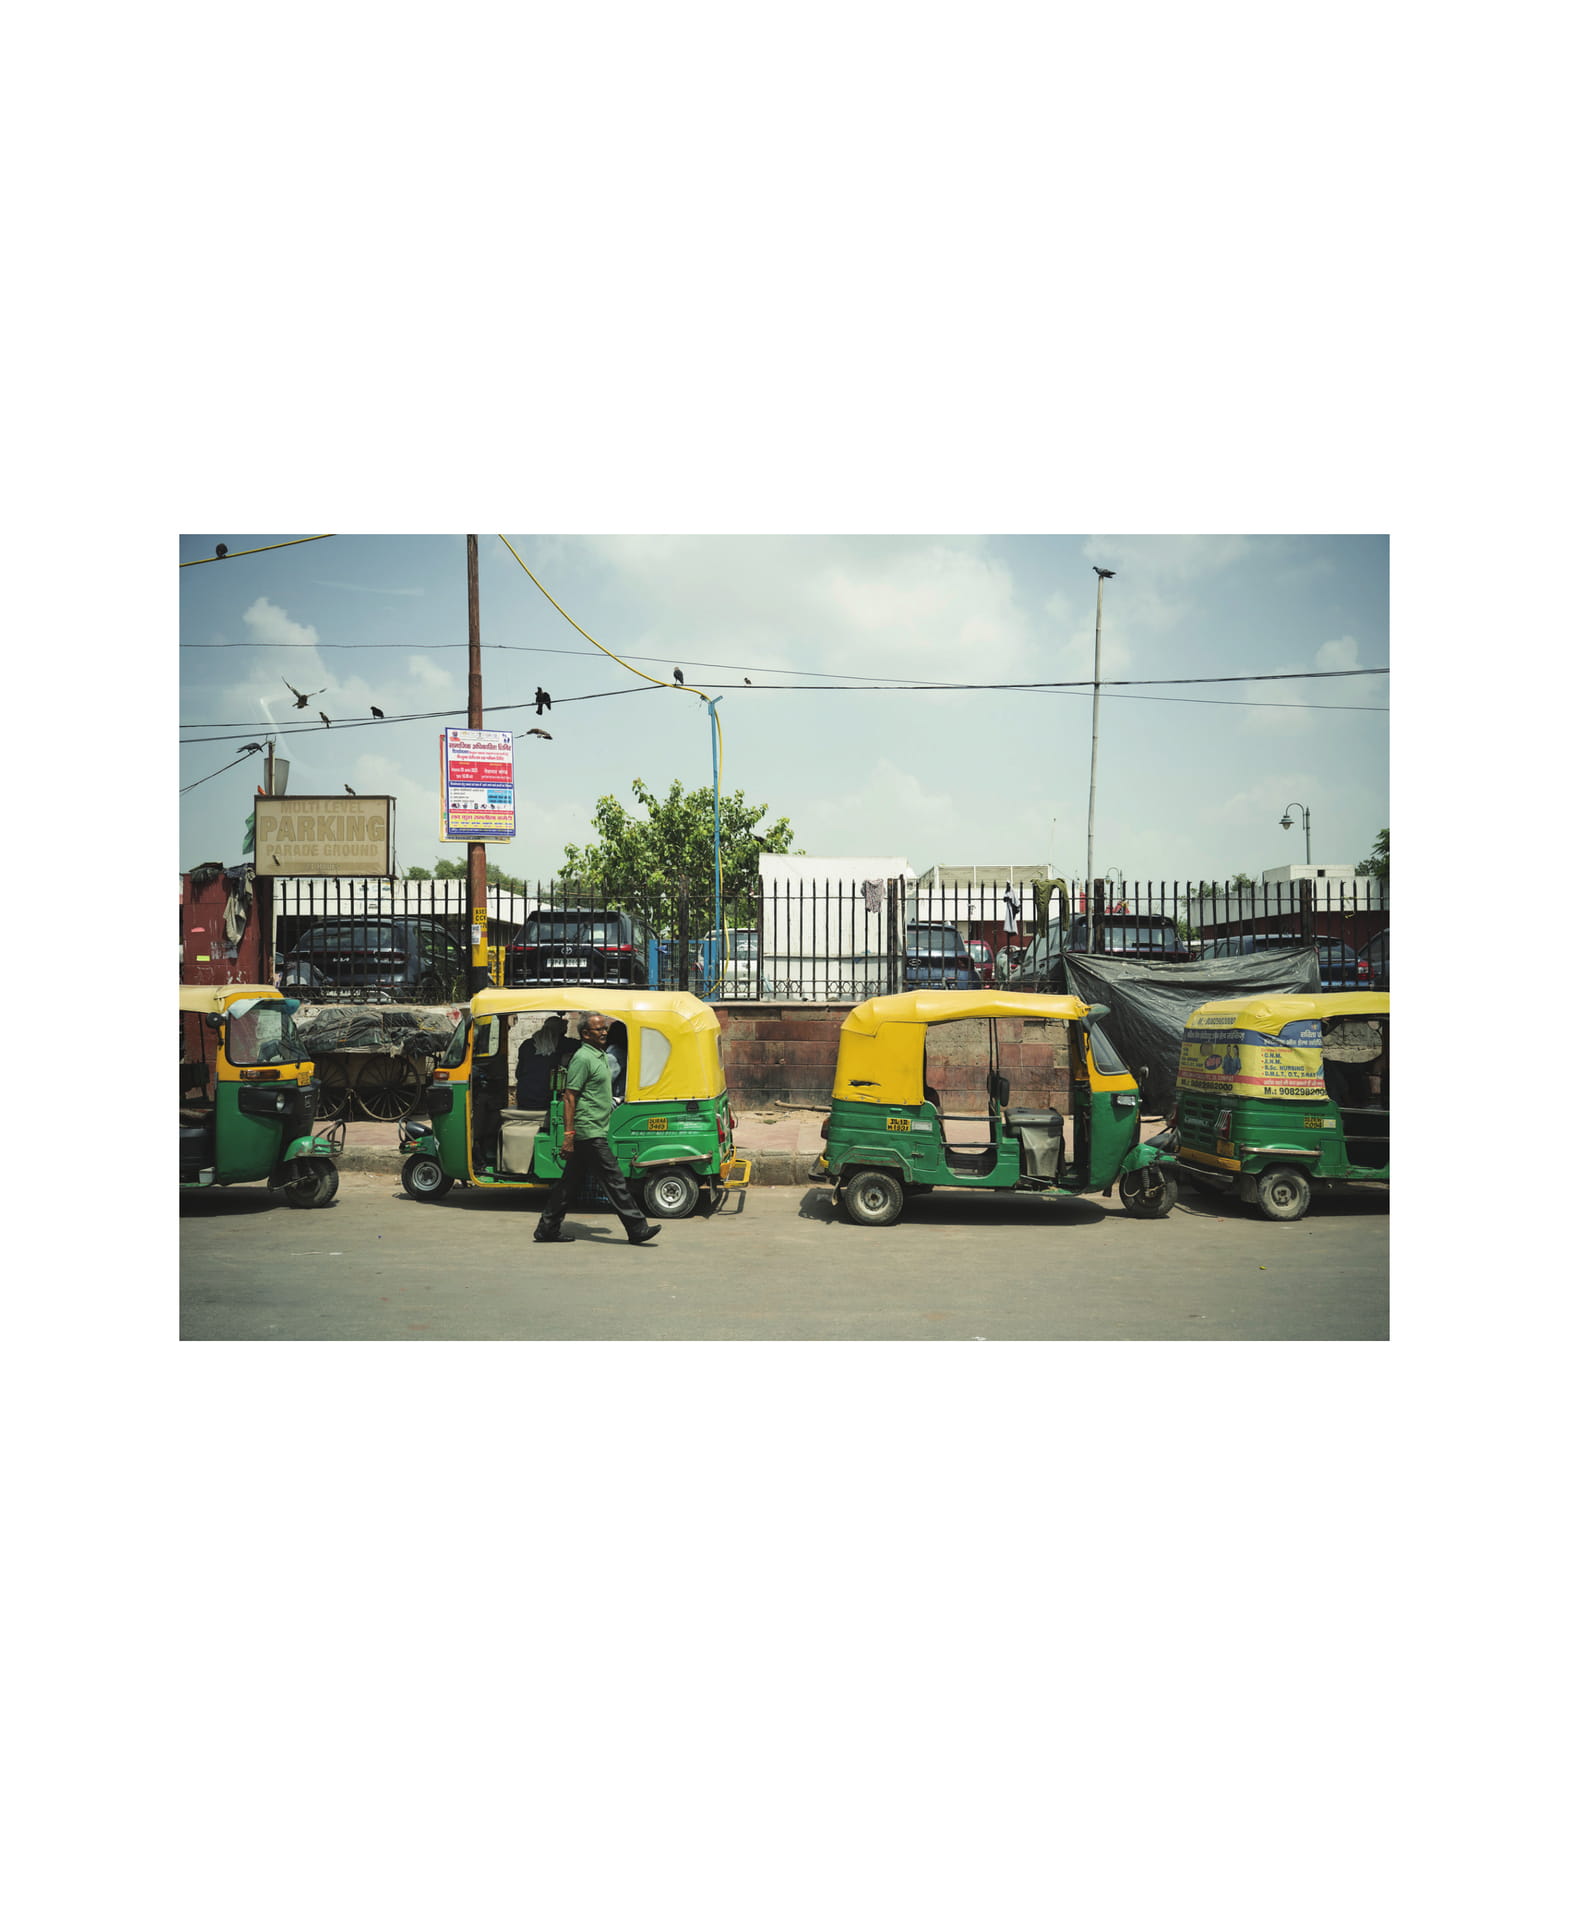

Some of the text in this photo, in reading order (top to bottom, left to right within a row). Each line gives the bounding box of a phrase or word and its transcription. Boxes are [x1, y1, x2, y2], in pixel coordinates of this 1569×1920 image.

[281, 801, 365, 813] MULTI LEVEL
[260, 815, 385, 842] PARKING
[266, 844, 378, 857] PARADE GROUND
